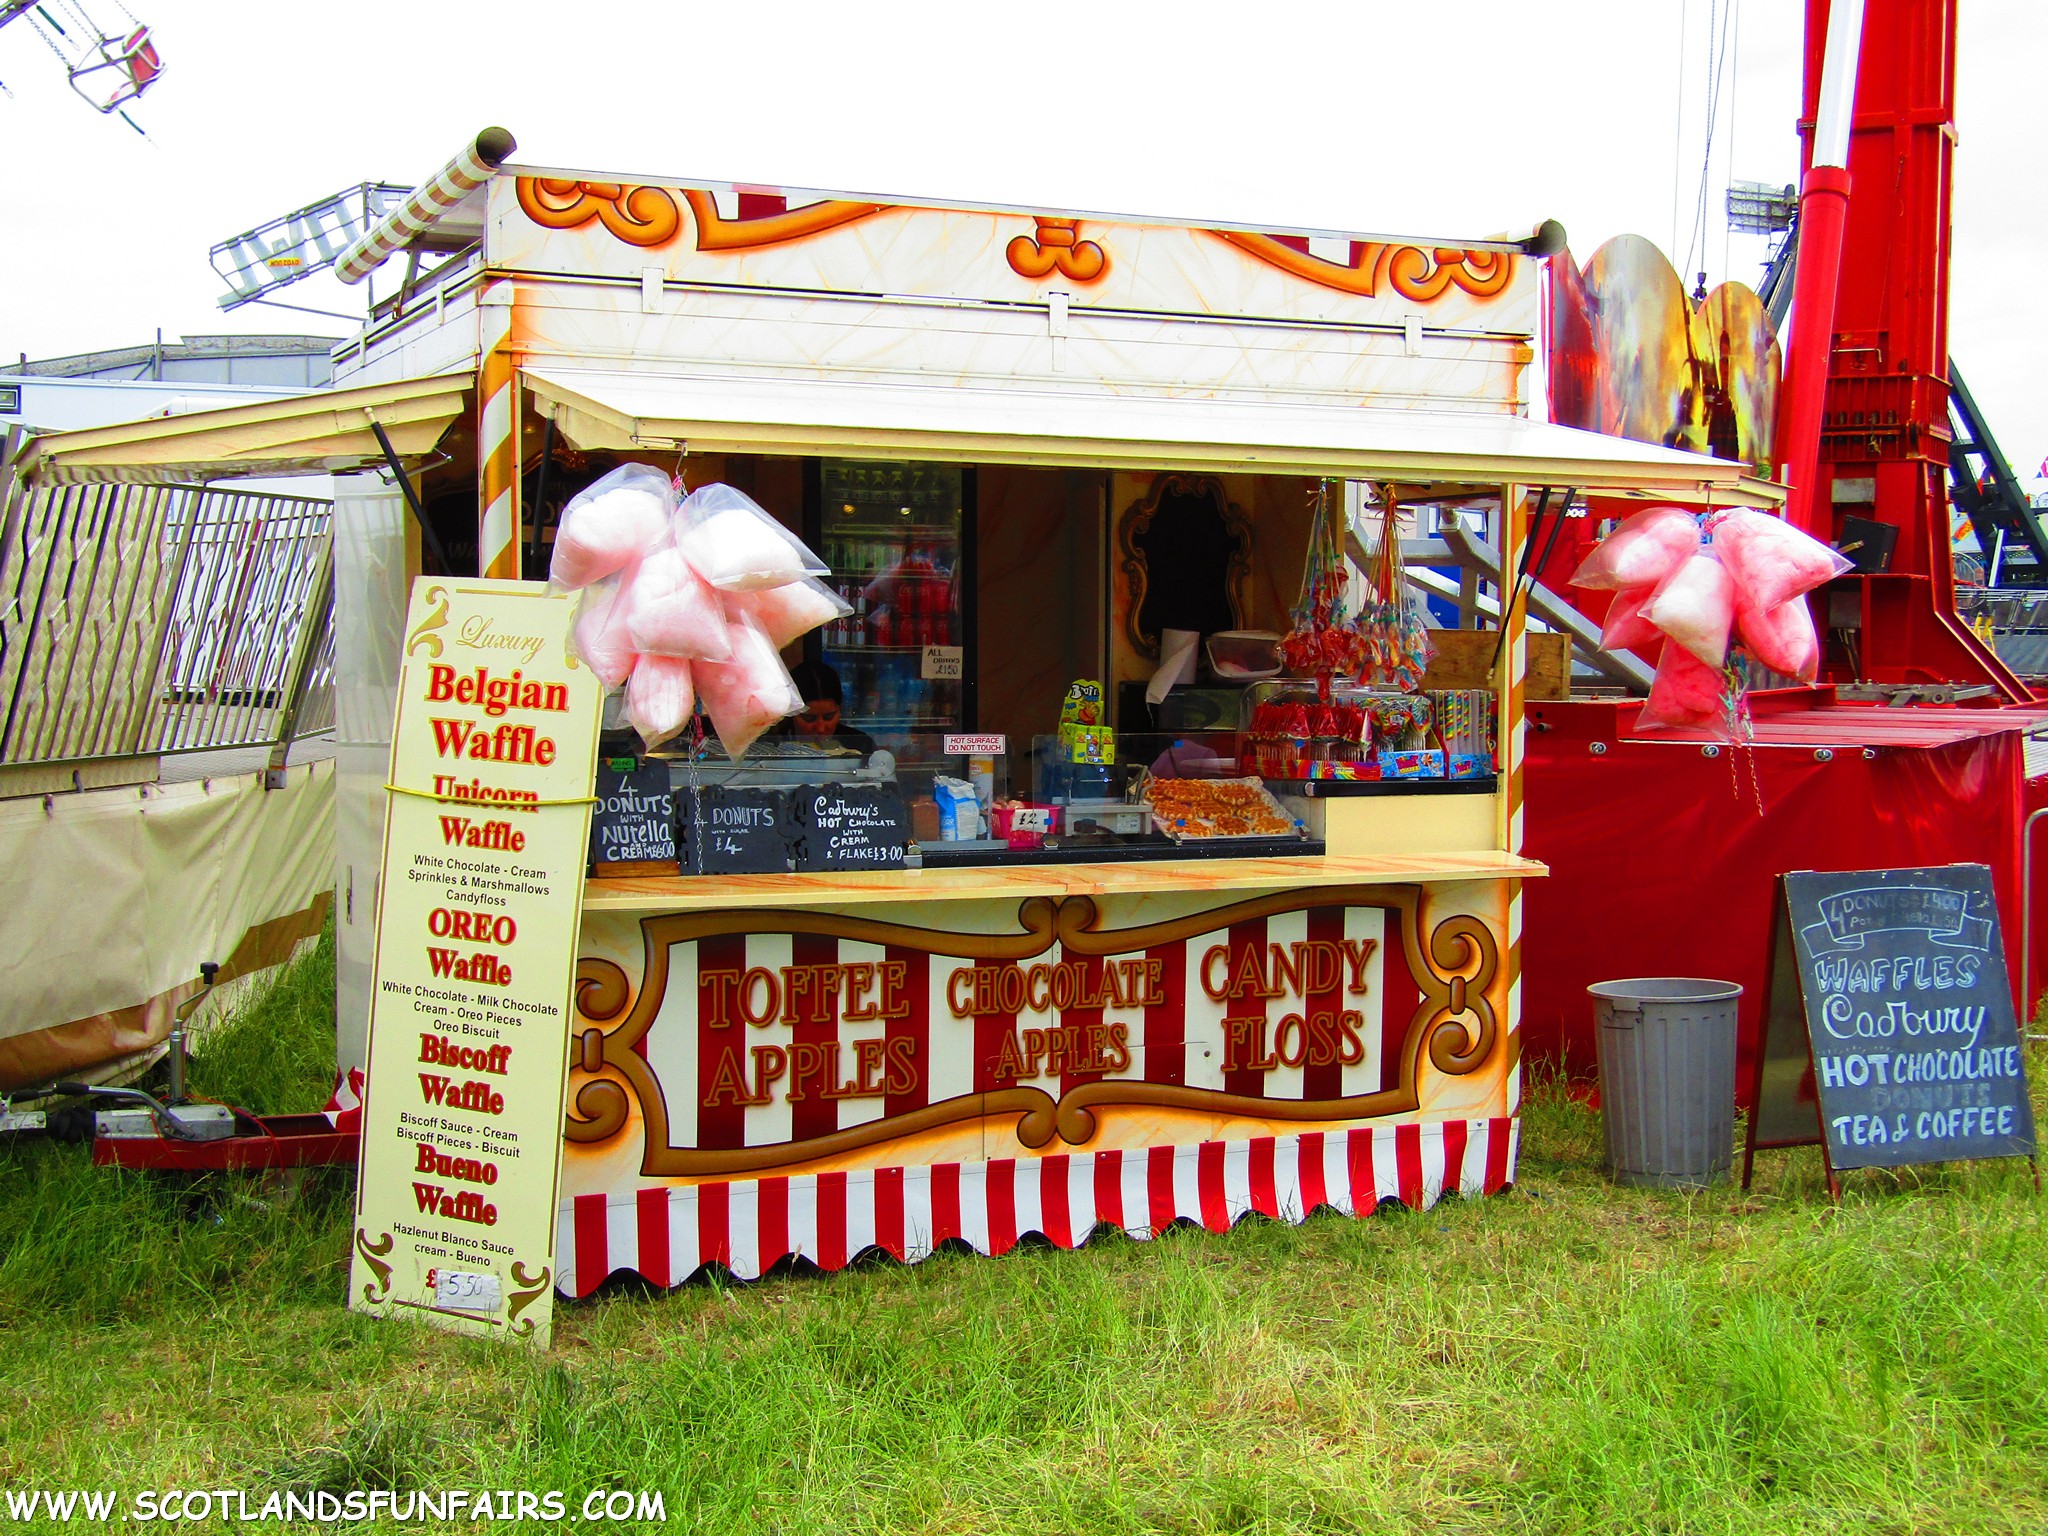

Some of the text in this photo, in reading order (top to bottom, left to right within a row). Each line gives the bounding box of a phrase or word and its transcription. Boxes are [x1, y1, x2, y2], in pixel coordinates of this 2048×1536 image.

[456, 615, 546, 664] Luxury
[424, 663, 569, 717] Belgian
[429, 717, 556, 767] Waffle
[433, 774, 539, 813] Unicorn
[594, 795, 672, 816] DONUTS
[619, 775, 639, 797] 4
[713, 806, 774, 827] DONUTS
[814, 796, 879, 821] Cadbury's
[818, 818, 896, 828] HOT CHOCOLATE
[1019, 812, 1038, 826] £2
[438, 815, 526, 853] Waffle
[829, 836, 869, 848] CREAM
[839, 848, 874, 859] FLAKE
[408, 869, 550, 896] Sprinkles & Marshmallows
[414, 855, 443, 868] White
[447, 858, 500, 874] Chocolate
[511, 866, 546, 879] Cream
[446, 889, 506, 907] Candyfloss
[428, 907, 518, 946] OREO
[427, 947, 512, 987] Waffle
[1200, 938, 1376, 1001] CANDY
[1815, 954, 1981, 993] WAFFLES
[383, 981, 411, 995] White
[415, 985, 467, 1003] Chocolate
[478, 994, 499, 1008] Milk
[502, 998, 558, 1016] Chocolate
[699, 961, 910, 1028] TOFFEE
[947, 958, 1164, 1018] CHOCOLATE
[414, 1001, 447, 1016] Cream
[458, 1007, 483, 1021] Oreo
[487, 1012, 522, 1027] Pieces
[434, 1019, 500, 1039] Oreo Biscuit
[1822, 993, 1986, 1050] Cadbury
[418, 1033, 512, 1075] Biscoff
[994, 1022, 1131, 1079] APPLES
[1221, 1010, 1364, 1072] FLOSS
[704, 1036, 919, 1107] APPLES
[1820, 1045, 2019, 1088] HOT CHOCOLATE
[418, 1073, 505, 1115] Waffle
[397, 1127, 434, 1143] Biscoff
[437, 1134, 472, 1149] Pieces
[482, 1142, 520, 1158] Biscuit
[400, 1112, 437, 1128] Biscoff
[440, 1119, 473, 1134] Sauce
[483, 1126, 518, 1142] Cream
[1832, 1114, 1888, 1145] TEA
[1916, 1105, 2013, 1140] COFFEE
[415, 1143, 498, 1185] Bueno
[412, 1182, 498, 1226] Waffle
[393, 1222, 514, 1256] Hazlenut Blanco Sauce
[414, 1243, 446, 1258] cream
[457, 1251, 491, 1266] Bueno
